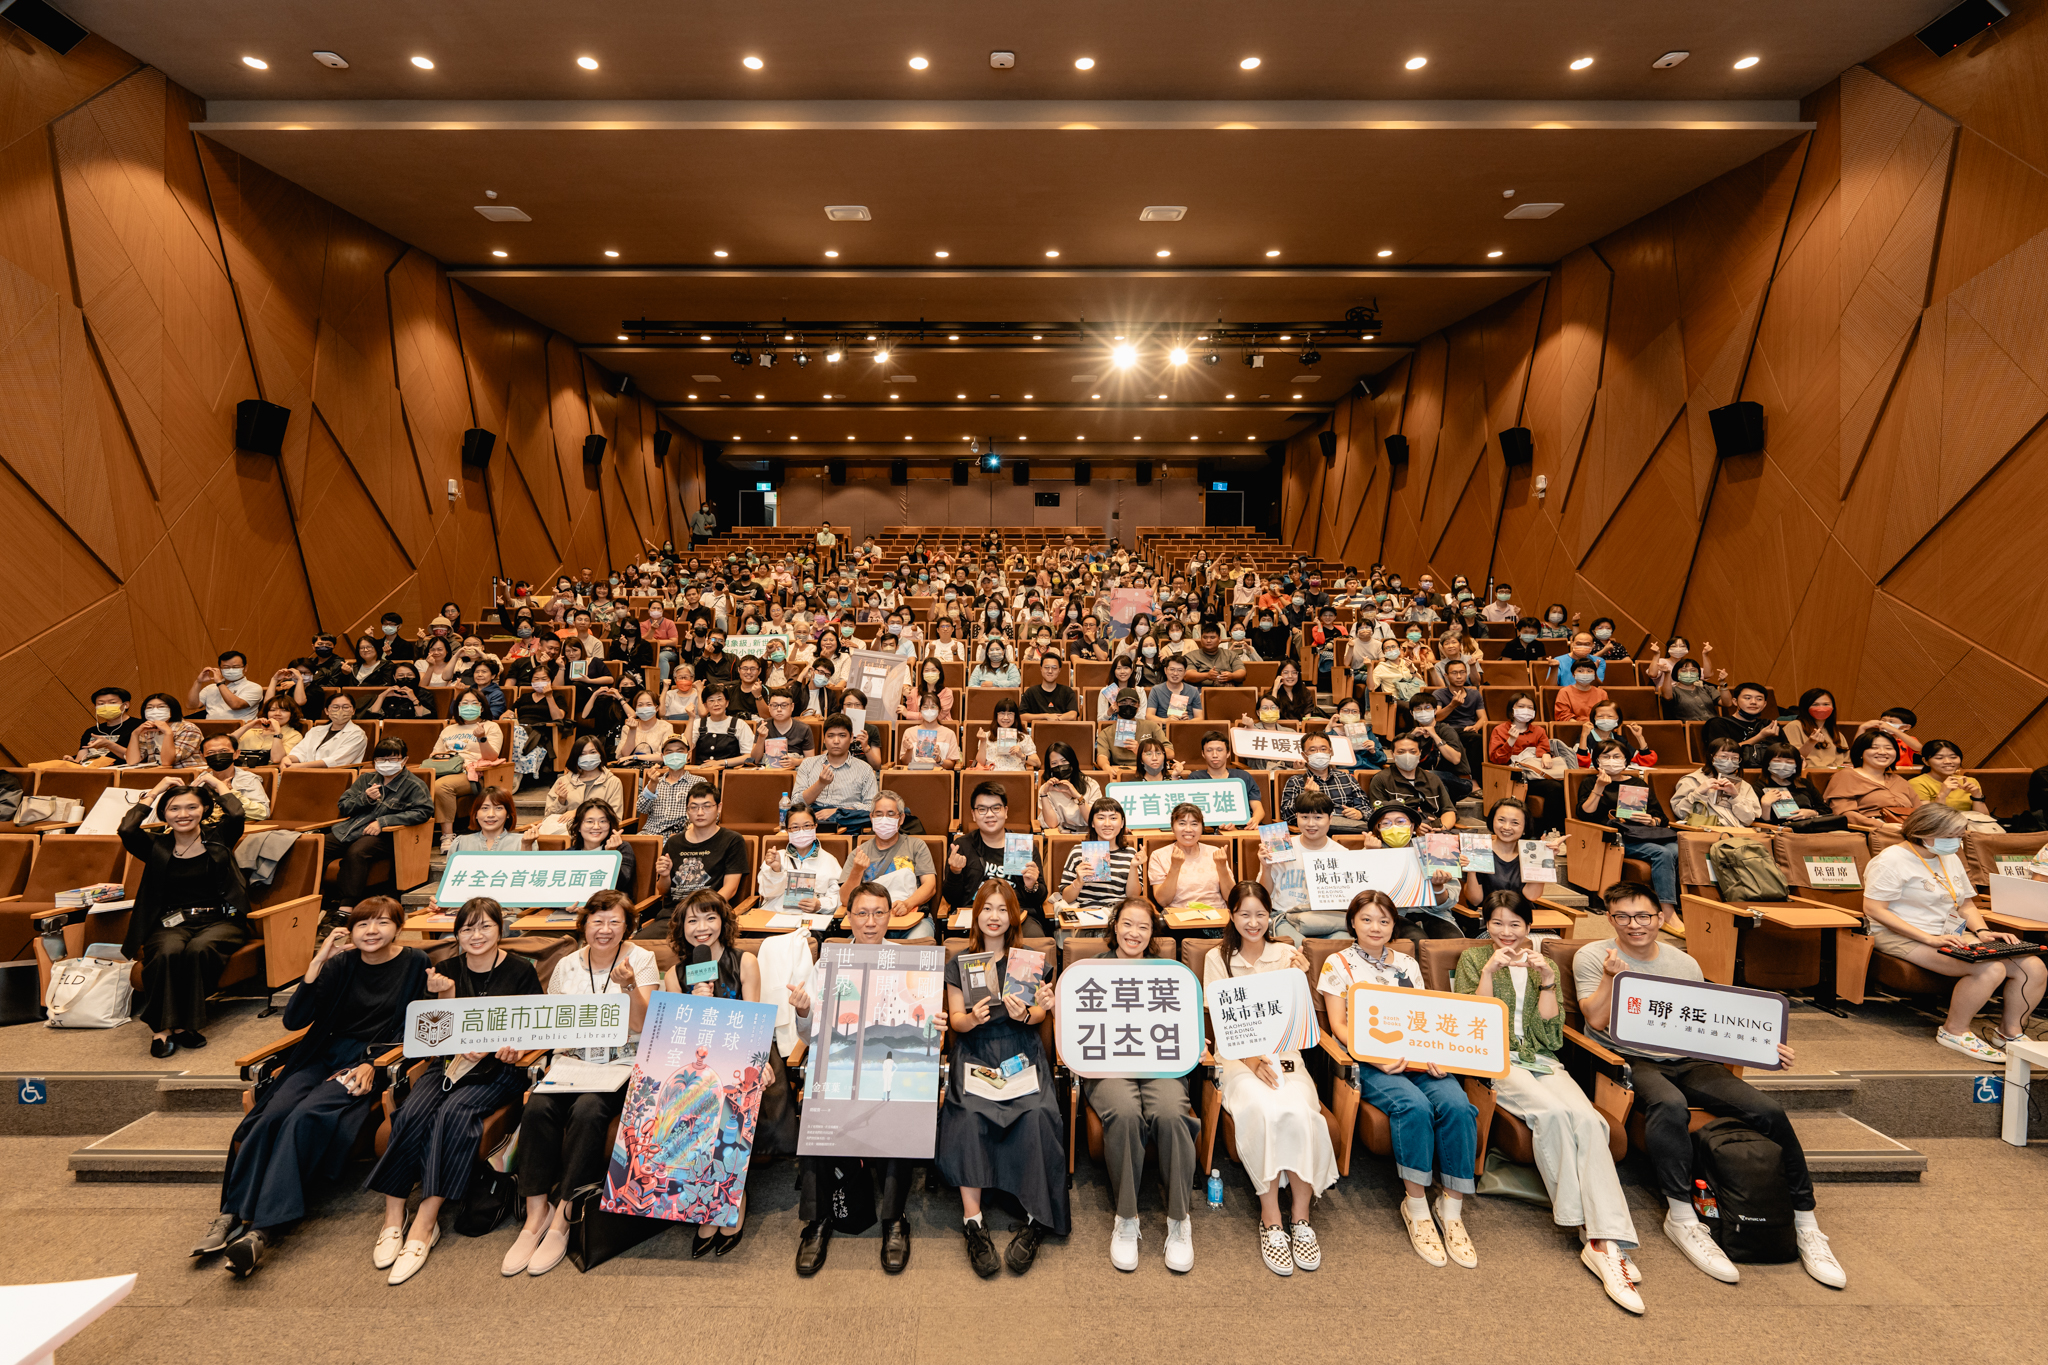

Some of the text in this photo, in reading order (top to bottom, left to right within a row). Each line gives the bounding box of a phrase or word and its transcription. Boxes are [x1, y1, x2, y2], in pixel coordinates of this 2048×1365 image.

[1120, 790, 1237, 816] #首選高雄
[1581, 839, 1586, 849] 3
[1313, 858, 1339, 871] 高雄
[1814, 866, 1848, 877] 保留席
[451, 869, 608, 888] #全台首場見面會
[1280, 869, 1307, 891] CALIF
[1315, 871, 1369, 884] 城市書展
[292, 916, 298, 928] 2
[1705, 921, 1711, 933] 2
[832, 948, 855, 996] 世界
[917, 950, 938, 998] 剛剛
[873, 948, 897, 1034] 離開的
[1075, 977, 1181, 1013] 金草葉
[1217, 986, 1248, 1006] 高雄
[461, 1003, 621, 1033] 高雄市立圖書館
[1221, 1000, 1284, 1023] 城市書展
[1648, 999, 1707, 1024] 聯經
[1714, 1013, 1773, 1032] LINKING
[695, 1006, 720, 1049] 盡頭
[722, 1010, 745, 1052] 地球
[1223, 1020, 1263, 1030] KAOHSIUNG
[1225, 1027, 1255, 1036] READING
[1406, 1009, 1488, 1041] 漫遊者
[460, 1031, 619, 1045] Kaohsiung Public Library
[1077, 1023, 1180, 1061] 김초엽
[1226, 1033, 1258, 1041] FESTIVAL
[1408, 1039, 1489, 1056] azoth books
[811, 1081, 841, 1093] 金草葉
